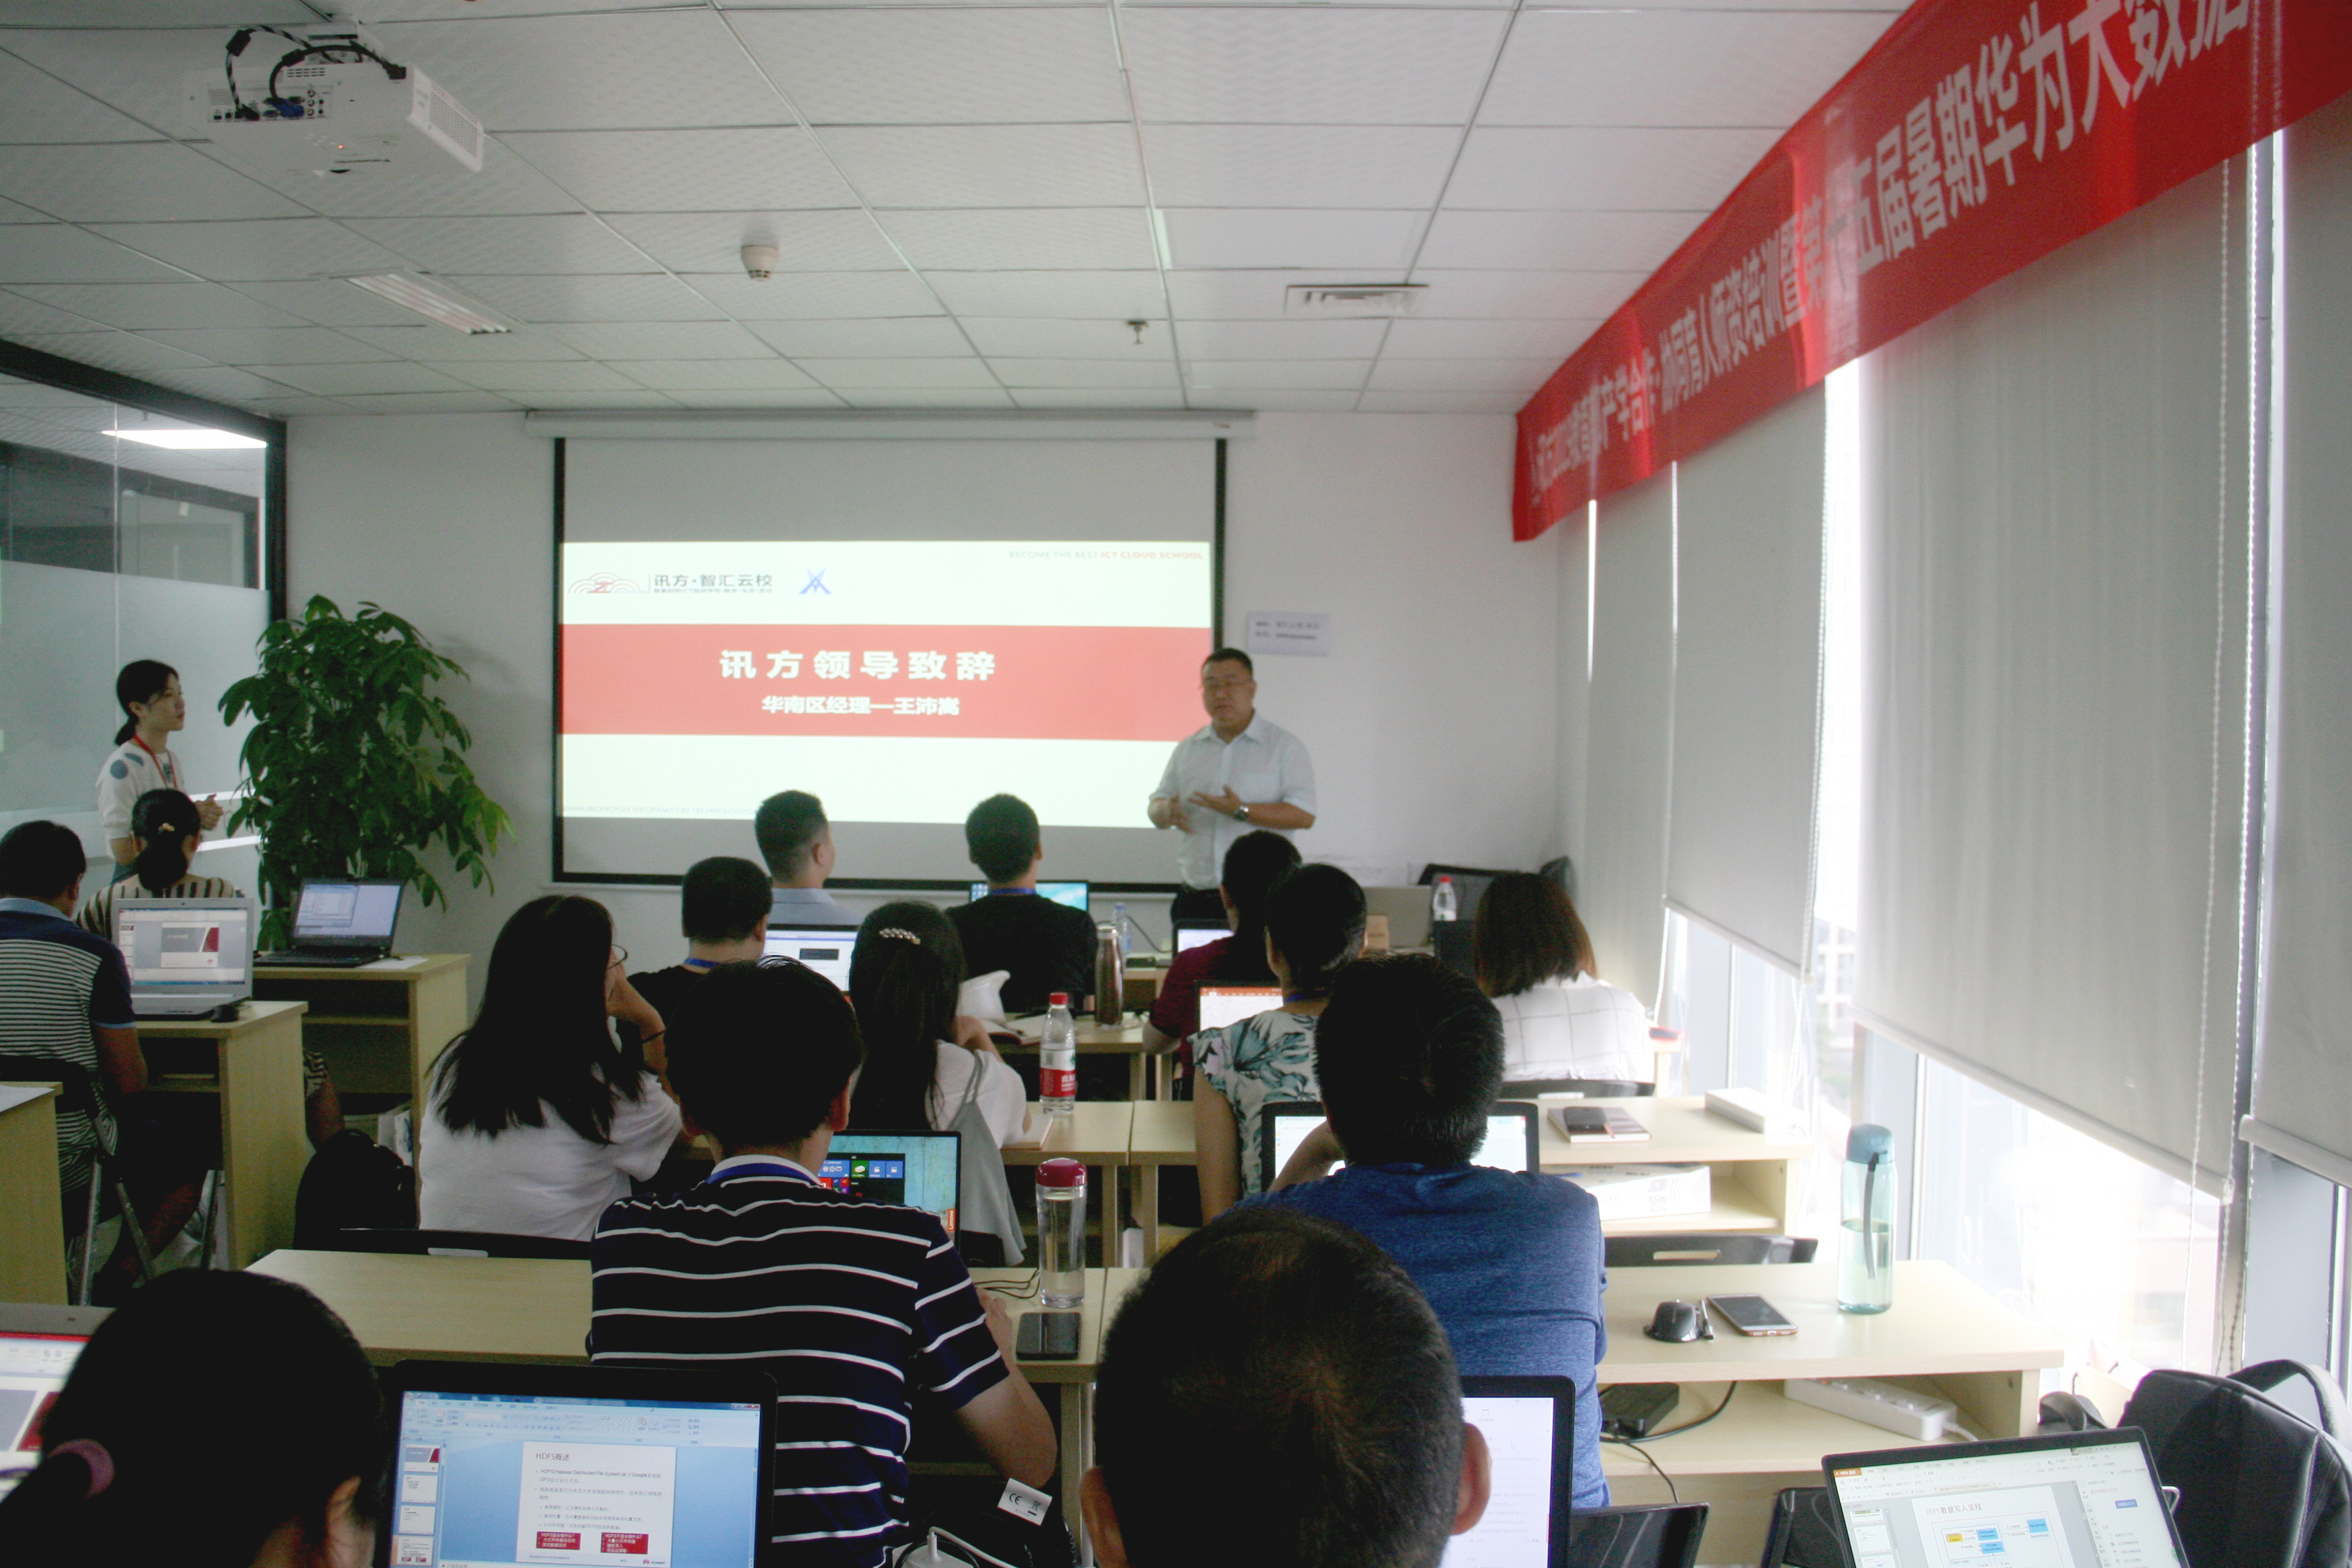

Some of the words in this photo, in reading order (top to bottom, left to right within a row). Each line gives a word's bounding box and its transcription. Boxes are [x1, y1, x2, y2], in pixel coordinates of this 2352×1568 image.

[720, 650, 995, 680] 讯方领导致辞
[536, 1452, 570, 1461] HDFS概述
